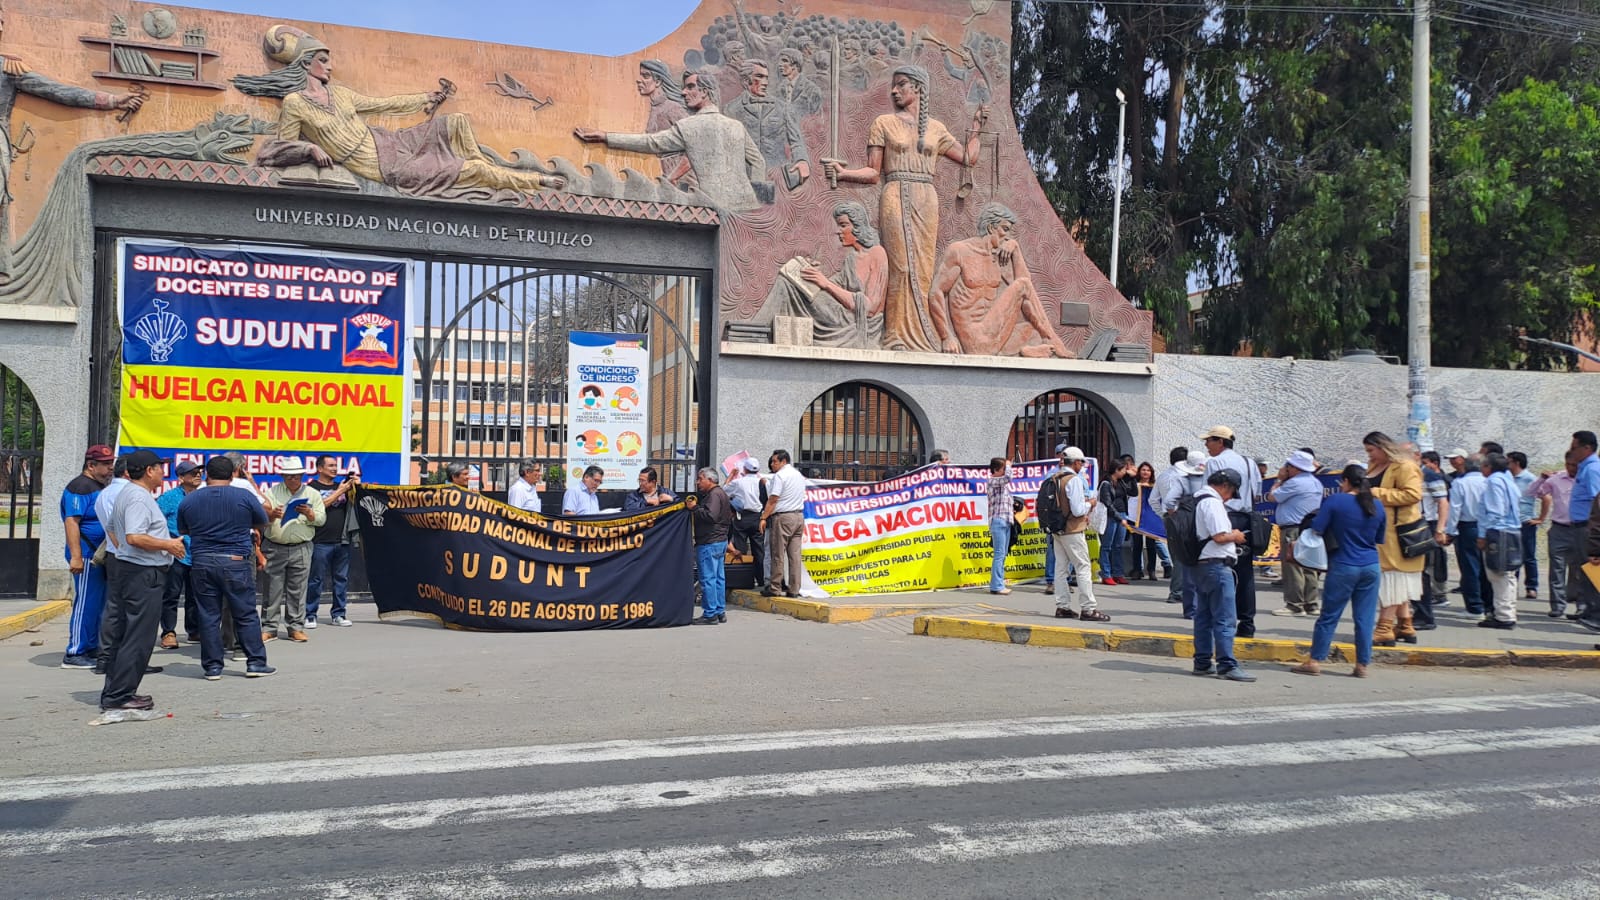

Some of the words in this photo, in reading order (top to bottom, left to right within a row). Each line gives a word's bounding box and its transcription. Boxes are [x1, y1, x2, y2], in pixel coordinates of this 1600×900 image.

[255, 207, 380, 230] UNIVERSIDAD
[387, 217, 480, 238] NACIONAL
[489, 226, 509, 240] DE
[515, 228, 593, 248] TRUJILLO
[133, 255, 249, 277] SINDICATO
[253, 263, 366, 284] UNIFICADO
[371, 270, 398, 287] DE
[156, 276, 270, 299] DOCENTES
[275, 285, 303, 300] DE
[308, 286, 335, 302] LA
[340, 288, 382, 305] UNT
[195, 316, 338, 351] SUDUNT
[350, 313, 393, 328] FENDUP
[578, 365, 639, 374] CONDICIONES
[129, 375, 248, 403] HUELGA
[254, 380, 395, 408] NACIONAL
[183, 414, 343, 442] INDEFINIDA
[337, 456, 362, 476] LA
[874, 467, 944, 493] UNIFICADO
[946, 467, 963, 479] DE
[1027, 466, 1042, 478] DE
[387, 488, 462, 510] SINDICATO
[552, 520, 572, 535] DE
[815, 490, 910, 517] UNIVERSIDAD
[913, 482, 973, 499] NACIONAL
[874, 501, 983, 534] NACIONAL
[483, 518, 553, 551] NACIONAL
[557, 537, 575, 553] DE
[580, 533, 645, 553] TRUJILLO
[973, 531, 982, 539] EL
[1025, 537, 1039, 546] LAS
[833, 552, 844, 561] DE
[846, 551, 857, 559] LA
[858, 538, 912, 556] UNIVERSIDAD
[968, 551, 983, 560] LOS
[829, 559, 890, 576] PRESUPUESTO
[891, 555, 914, 564] PARA
[916, 551, 932, 560] LAS
[468, 600, 485, 616] EL
[489, 600, 507, 617] 26
[510, 601, 530, 619] DE
[534, 603, 596, 621] AGOSTO
[600, 603, 619, 620] DE
[622, 601, 654, 619] 1986
